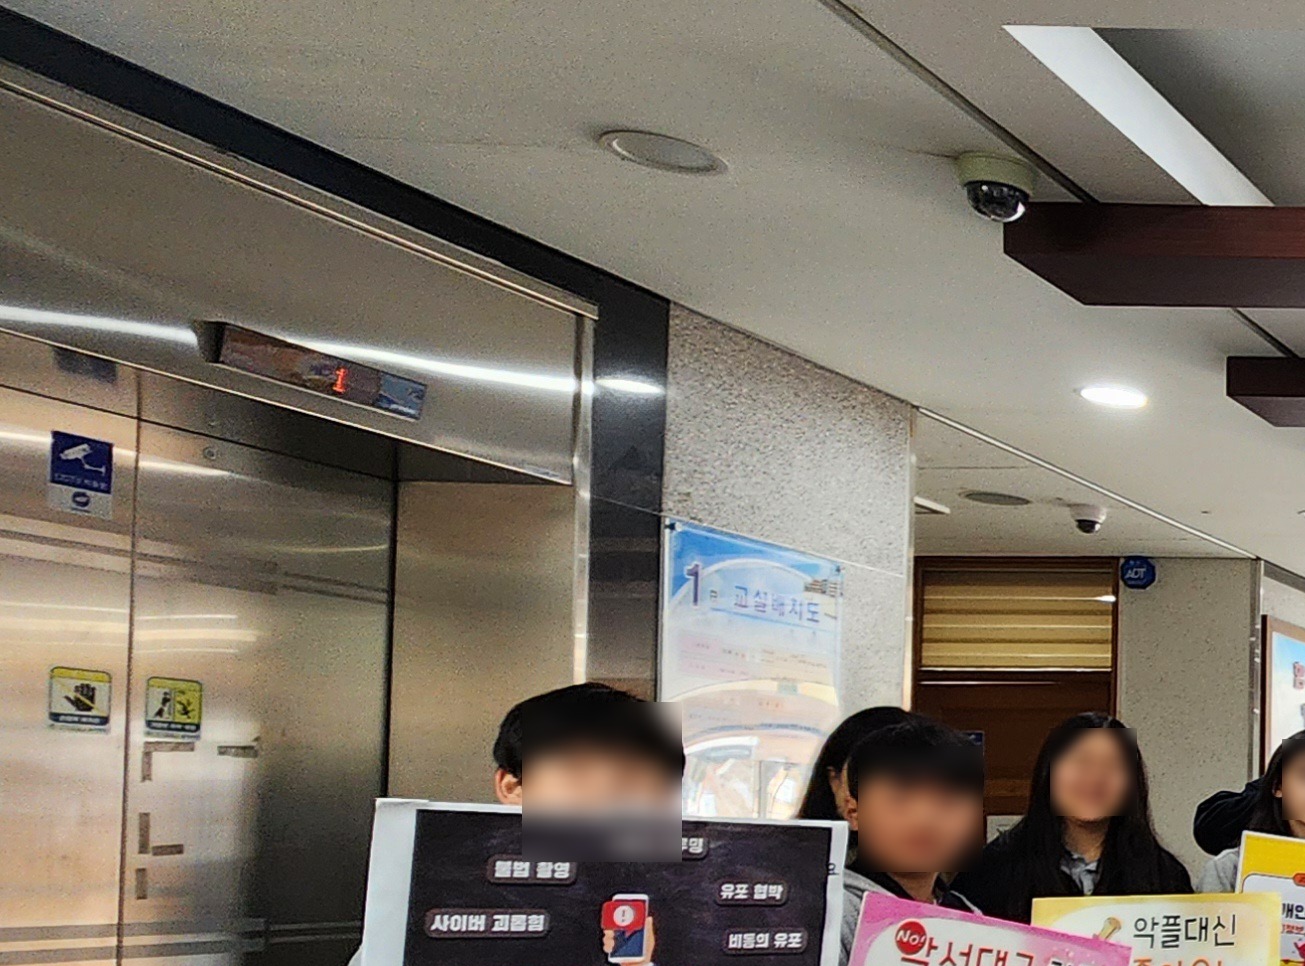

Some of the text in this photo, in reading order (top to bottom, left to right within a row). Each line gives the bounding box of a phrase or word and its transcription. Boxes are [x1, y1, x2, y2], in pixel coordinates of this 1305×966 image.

[332, 367, 347, 394] 1
[1124, 568, 1147, 579] ADT
[686, 564, 700, 606] 1
[720, 883, 784, 900] 유포 협박
[430, 914, 486, 932] 사이버
[1132, 913, 1238, 949] 악플대신
[728, 932, 803, 949] 비동의 유포
